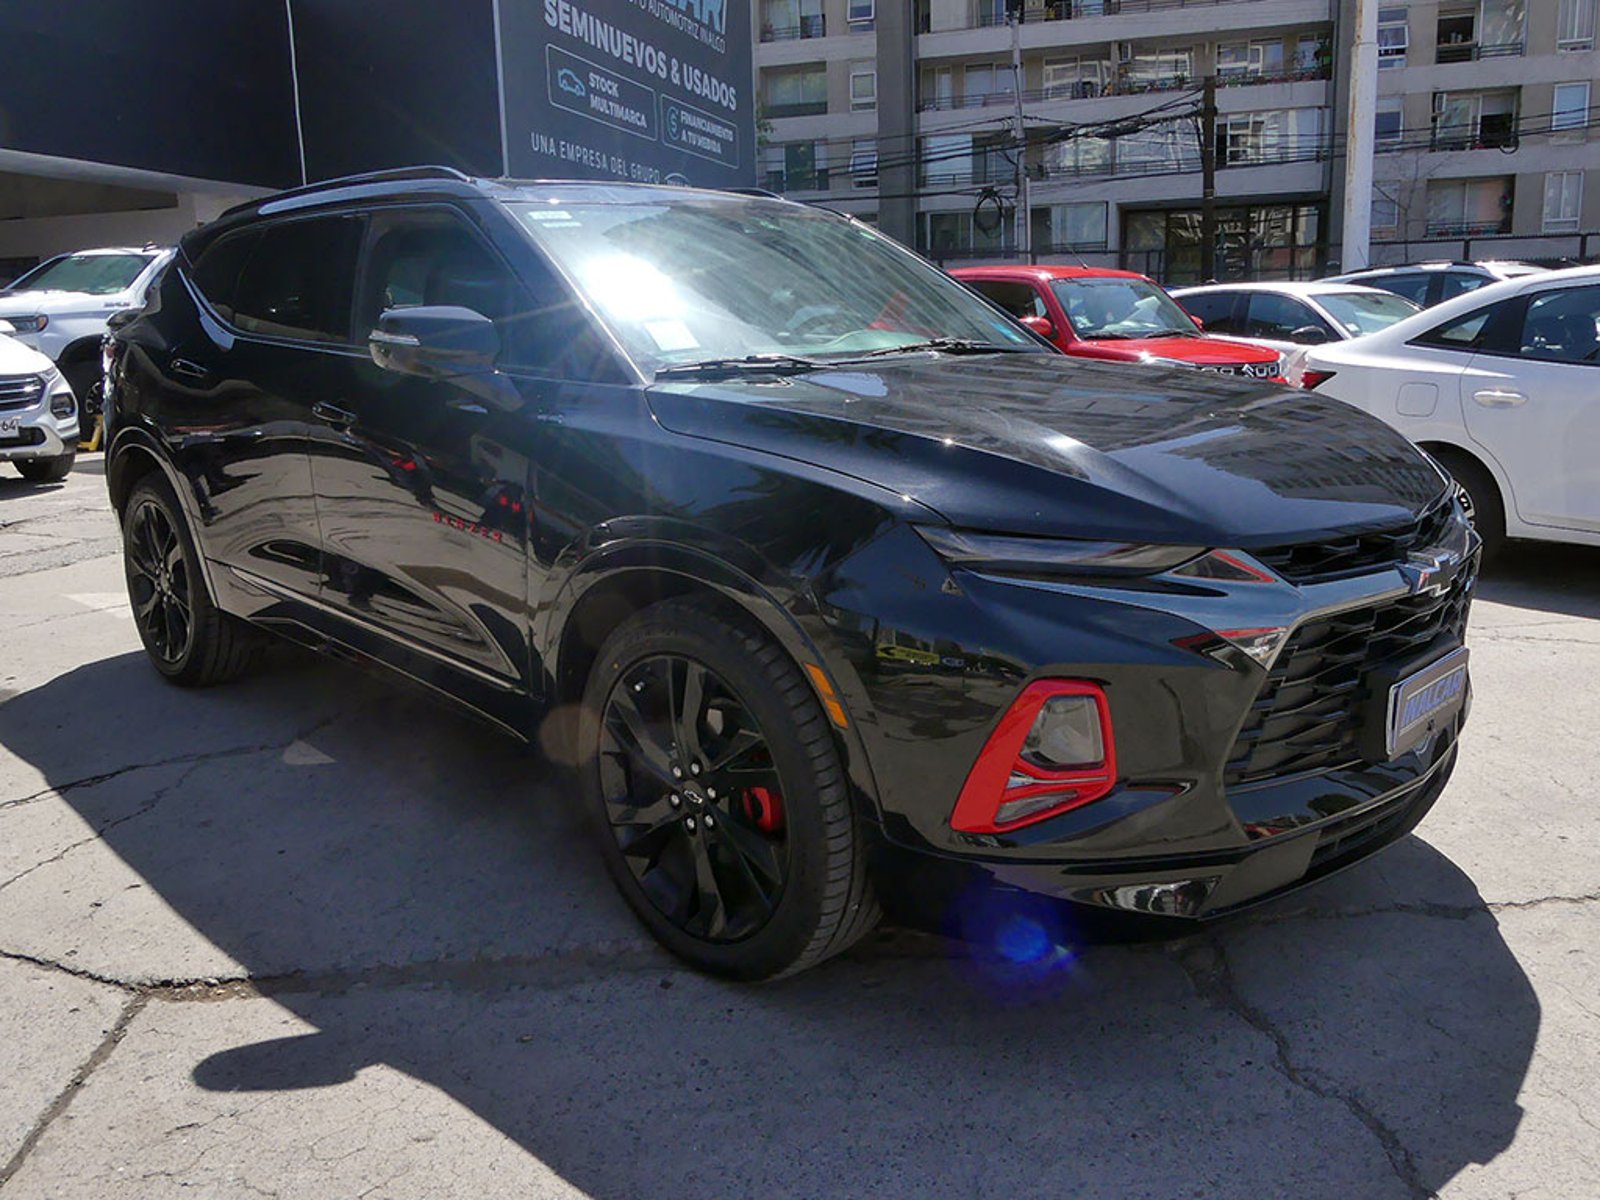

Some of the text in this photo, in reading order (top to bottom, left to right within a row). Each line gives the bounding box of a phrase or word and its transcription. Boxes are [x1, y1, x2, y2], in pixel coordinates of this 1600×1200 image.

[544, 0, 667, 79] SEMINUEVOS
[671, 57, 681, 87] &
[683, 63, 737, 111] USADOS
[588, 72, 620, 98] STOCK
[590, 94, 647, 128] MULTIMARCA
[530, 131, 660, 184] UNA EMPRESA DEL GRUPO
